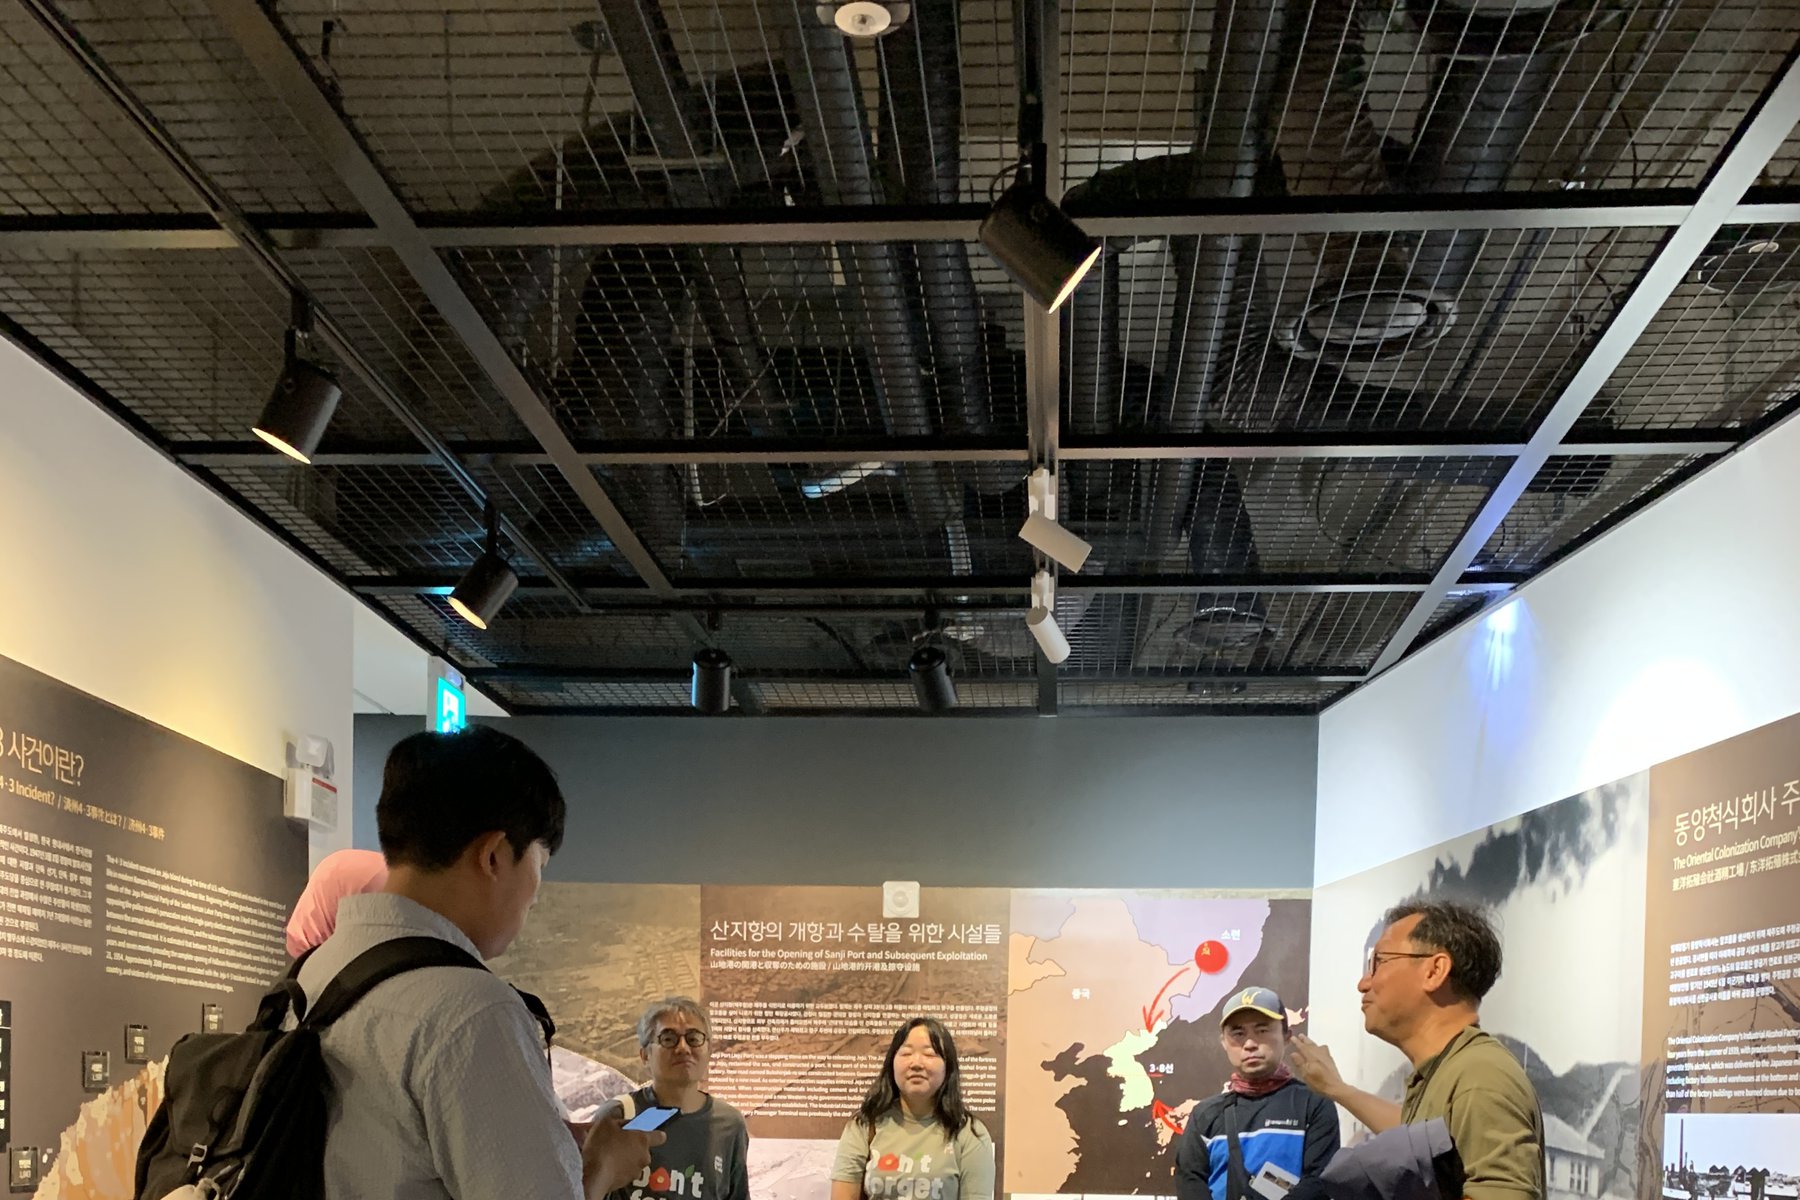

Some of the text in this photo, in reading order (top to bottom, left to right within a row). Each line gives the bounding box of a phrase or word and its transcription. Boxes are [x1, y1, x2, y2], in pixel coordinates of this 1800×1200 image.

[7, 731, 85, 787] 사건이란?
[16, 780, 55, 806] Incident?
[1674, 786, 1777, 847] 동양척식회사
[1673, 856, 1686, 871] The
[1686, 847, 1714, 868] Oriental
[1714, 838, 1760, 860] Colonization
[710, 920, 1002, 944] 산지항의 개항과 수탈을 위한 시설들
[1221, 929, 1241, 941] 소련
[710, 948, 988, 961] Facilities for the Opening of Sanji Port and Subsequent Exploitation
[1071, 988, 1091, 1000] 중국
[1241, 990, 1261, 1005] W
